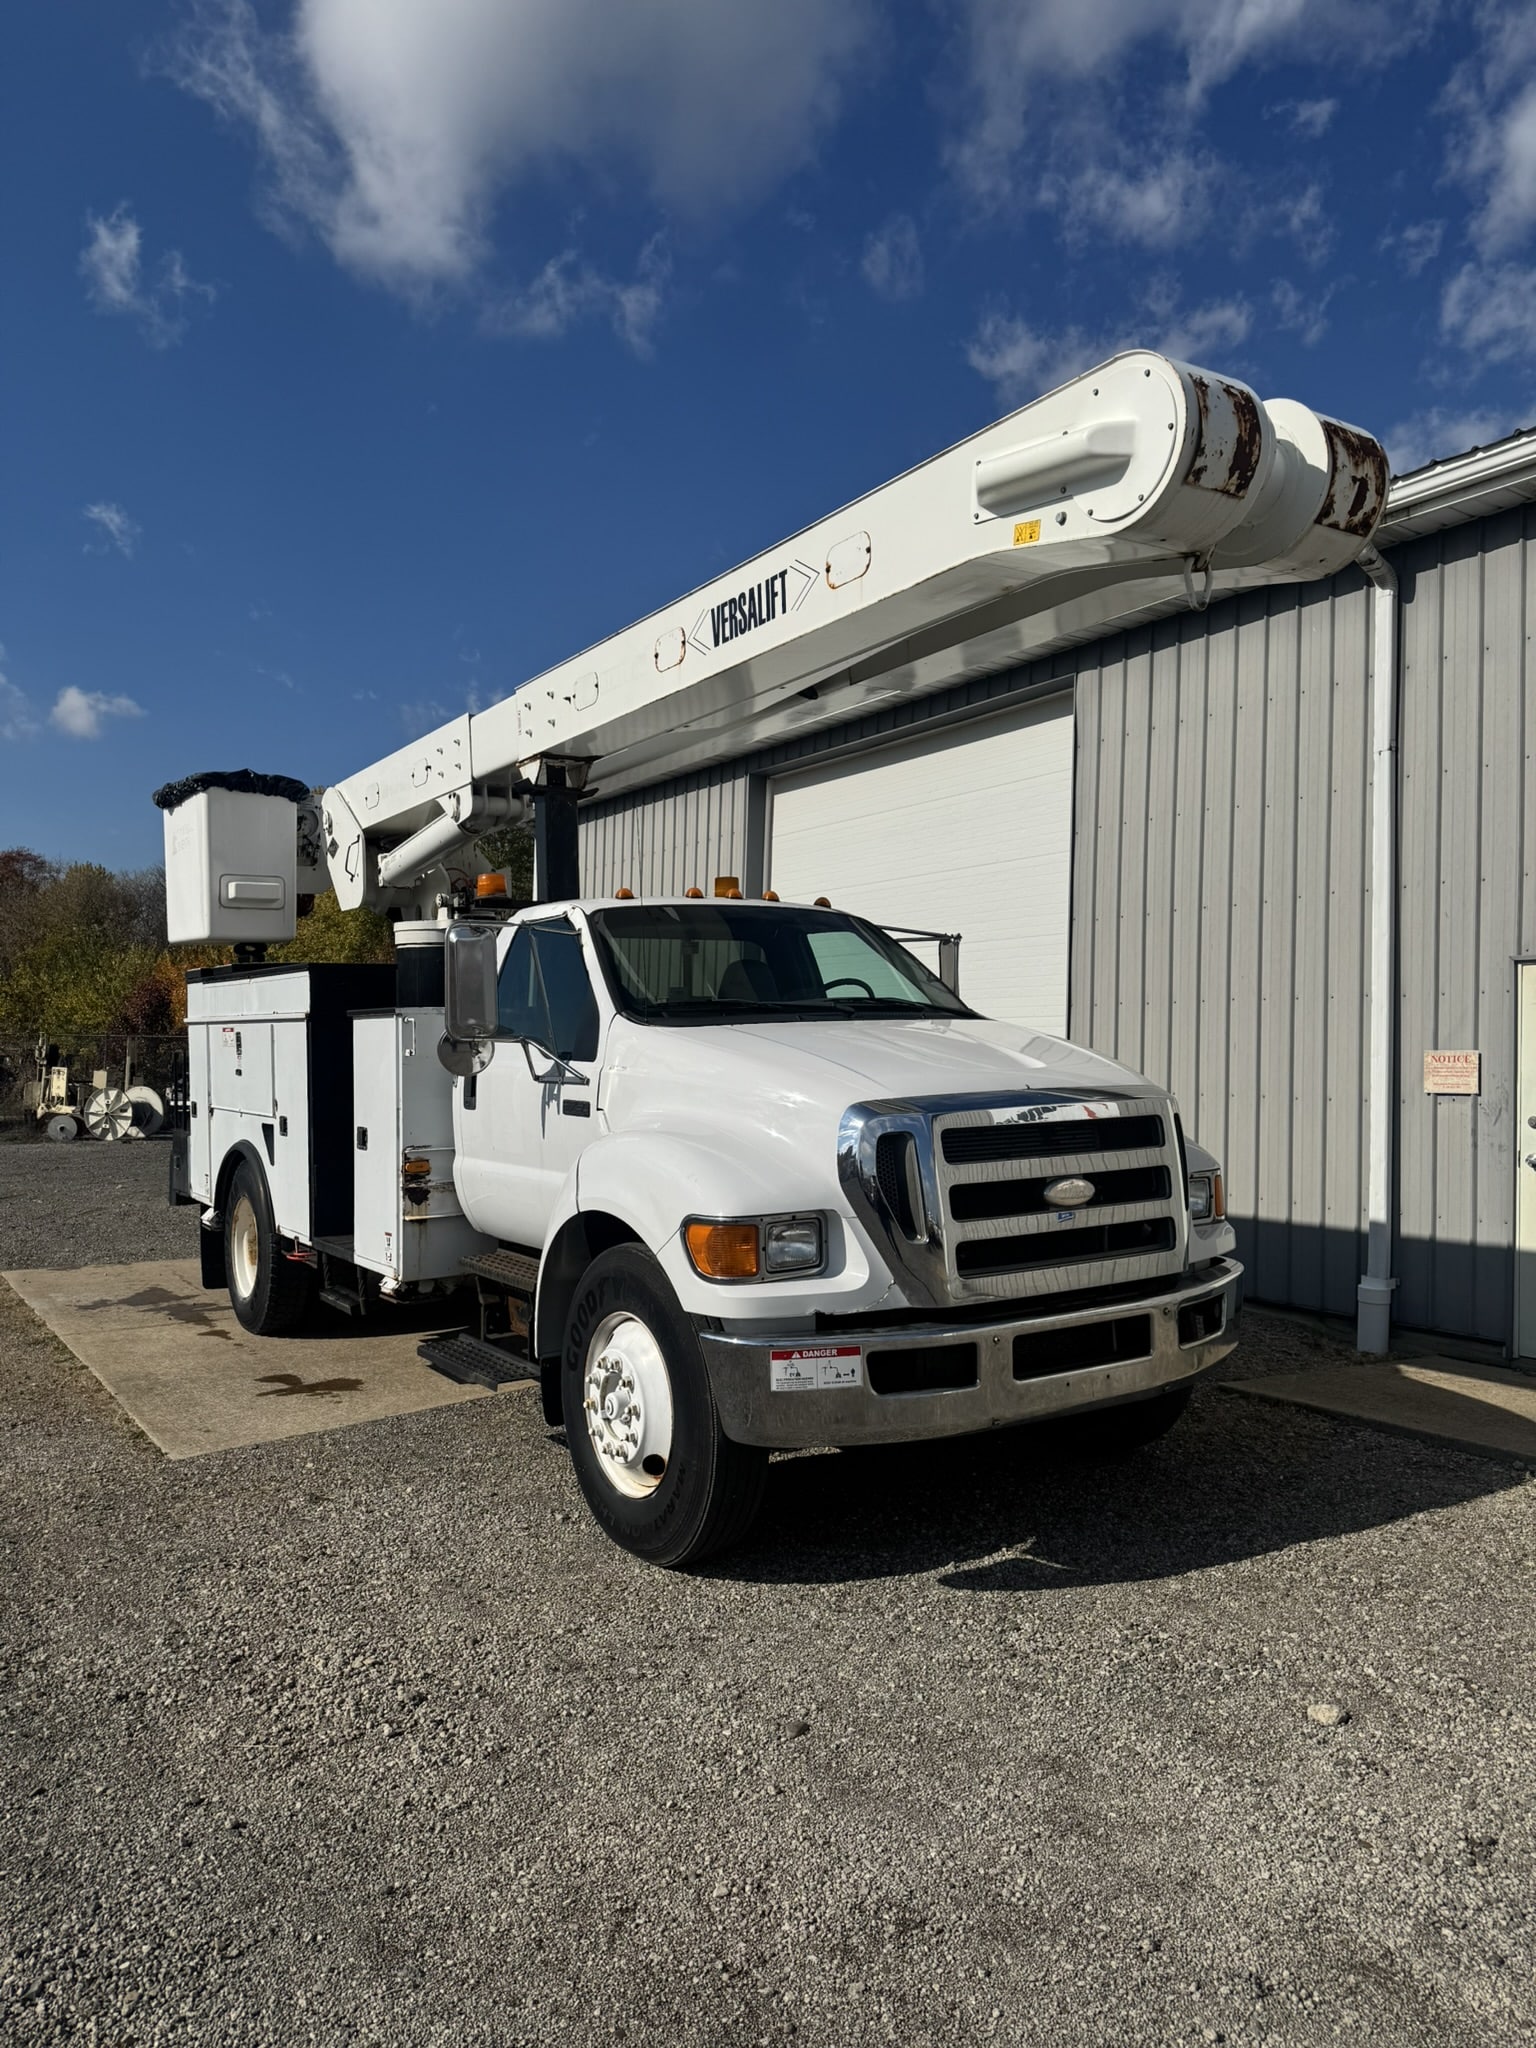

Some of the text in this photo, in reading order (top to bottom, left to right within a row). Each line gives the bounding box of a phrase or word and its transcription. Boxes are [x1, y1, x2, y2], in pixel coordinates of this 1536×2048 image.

[711, 569, 787, 648] VERSALIFT
[1431, 1055, 1472, 1064] NOTICE
[802, 1349, 838, 1358] DANGER
